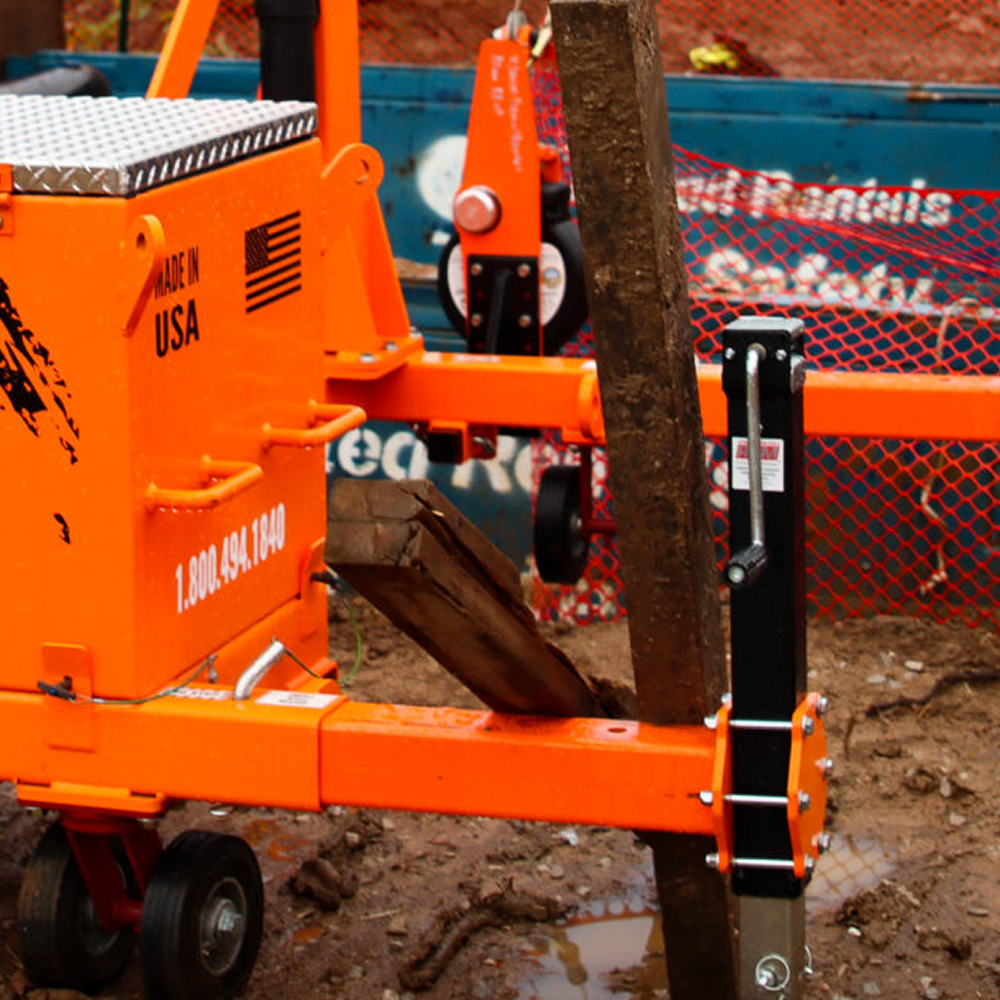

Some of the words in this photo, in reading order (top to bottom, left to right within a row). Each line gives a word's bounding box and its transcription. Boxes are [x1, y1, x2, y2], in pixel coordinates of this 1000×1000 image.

[187, 245, 199, 286] IN
[155, 299, 199, 357] USA
[175, 502, 286, 613] 1.800.494.1840
